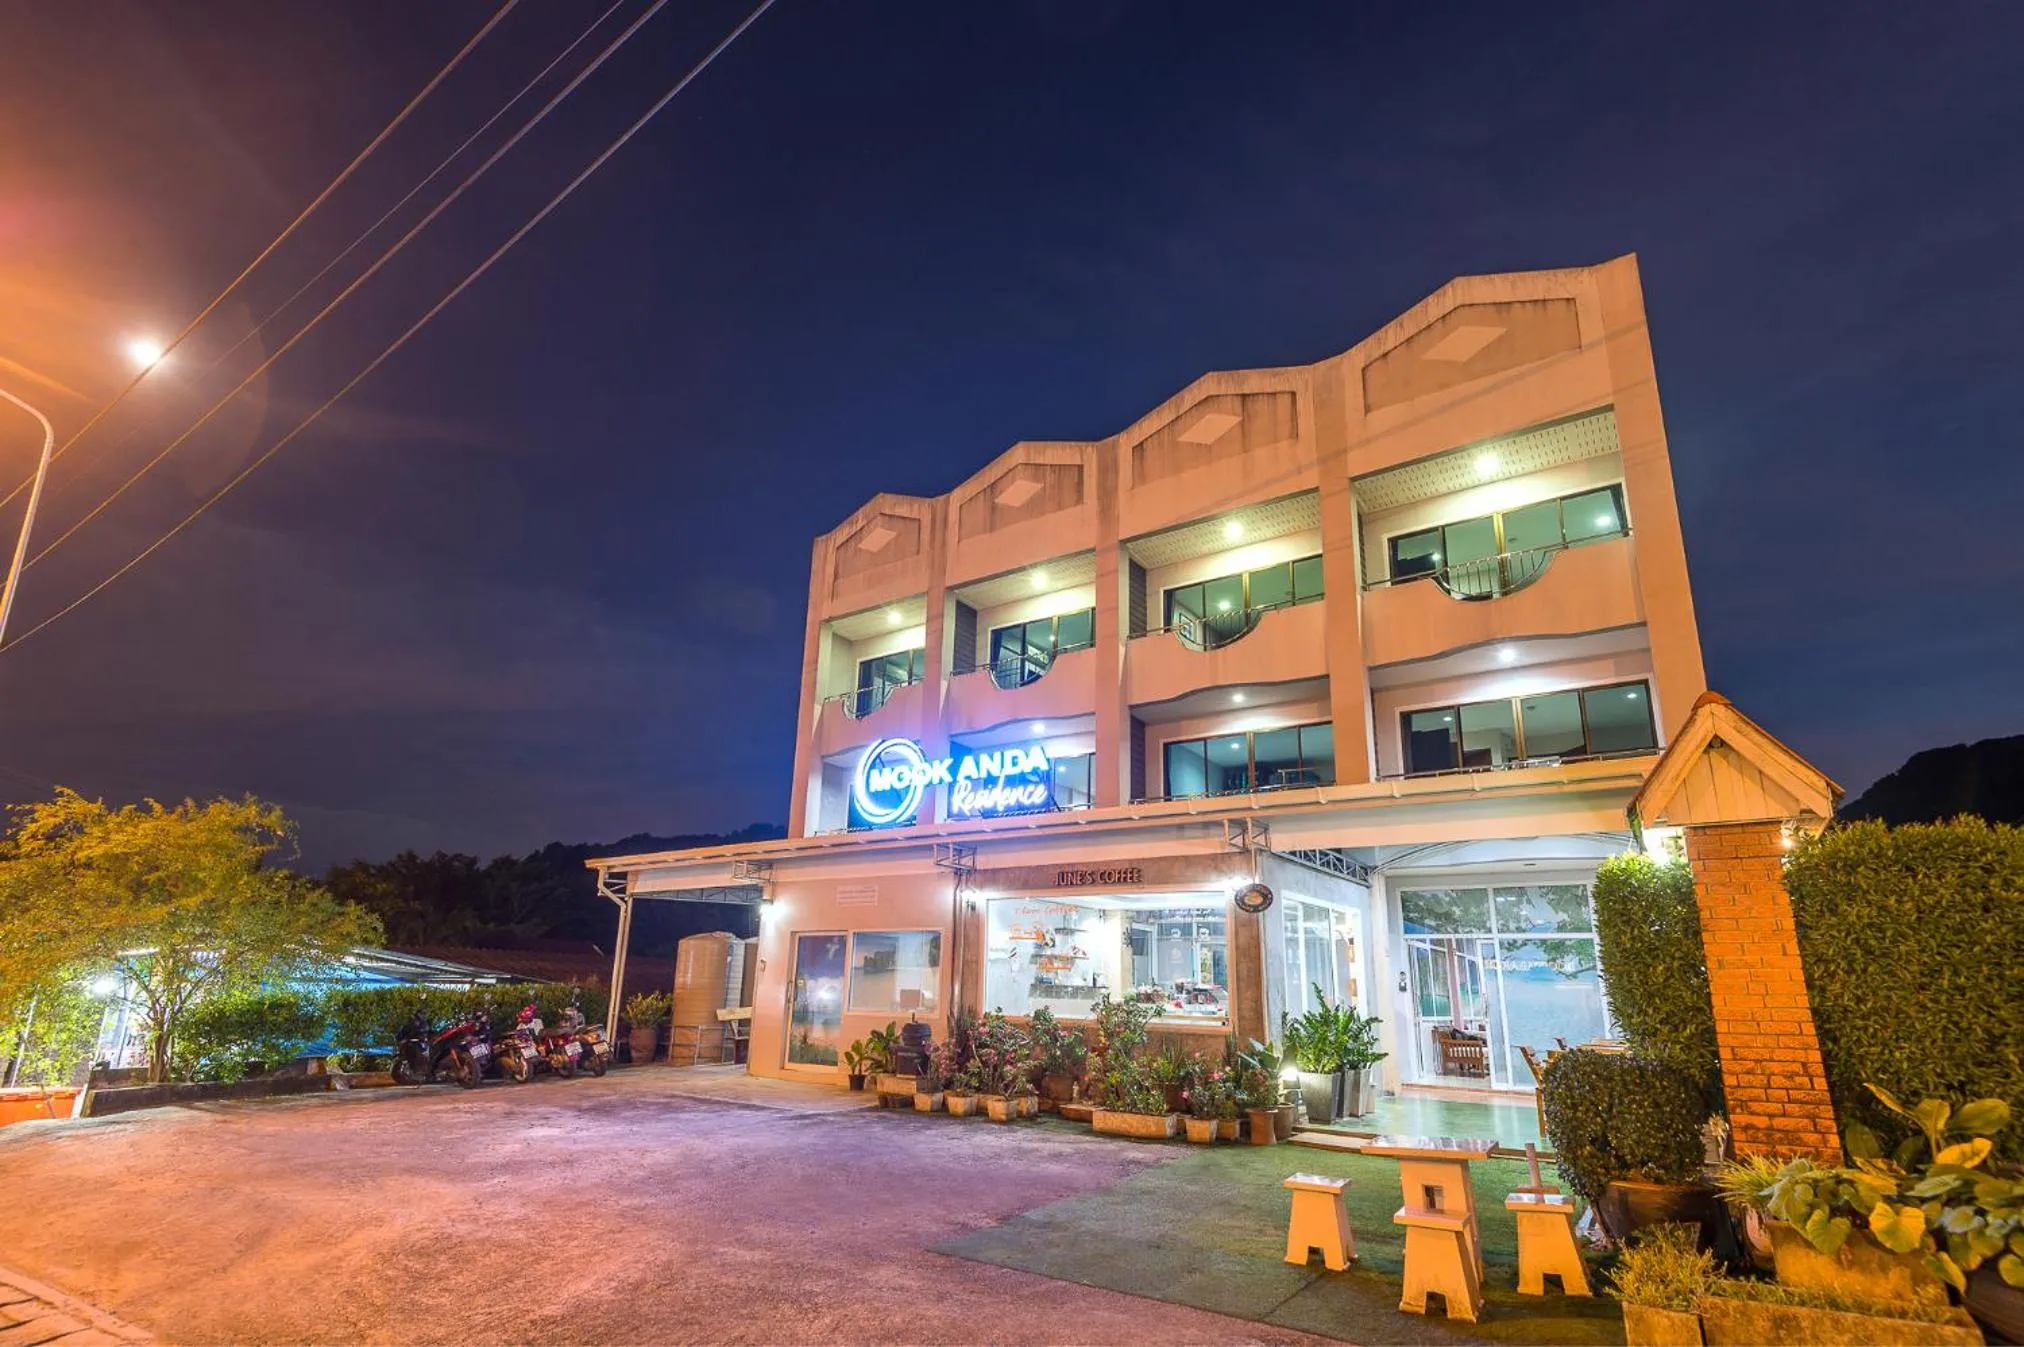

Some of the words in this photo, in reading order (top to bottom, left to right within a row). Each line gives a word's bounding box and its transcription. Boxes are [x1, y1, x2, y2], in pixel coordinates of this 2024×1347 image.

[868, 758, 953, 793] MOOK
[956, 746, 1050, 780] ANDA
[951, 775, 1048, 816] Residence
[1097, 867, 1141, 884] COFFEE
